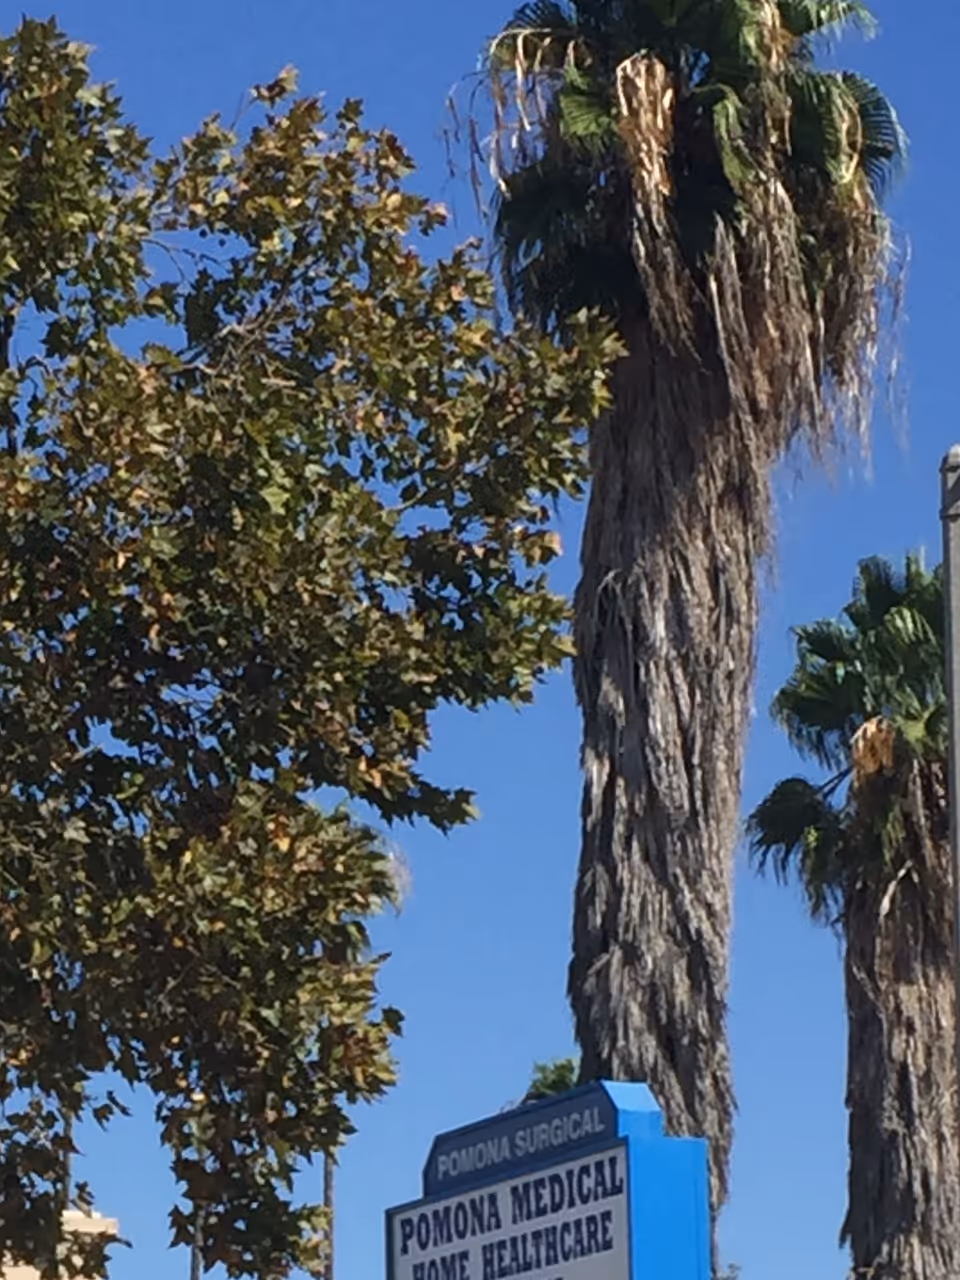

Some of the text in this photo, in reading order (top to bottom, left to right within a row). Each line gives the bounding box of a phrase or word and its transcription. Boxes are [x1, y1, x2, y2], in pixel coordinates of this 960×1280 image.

[437, 1107, 606, 1180] POMONA SURGICAL
[400, 1156, 624, 1256] POMONA MEDICAL
